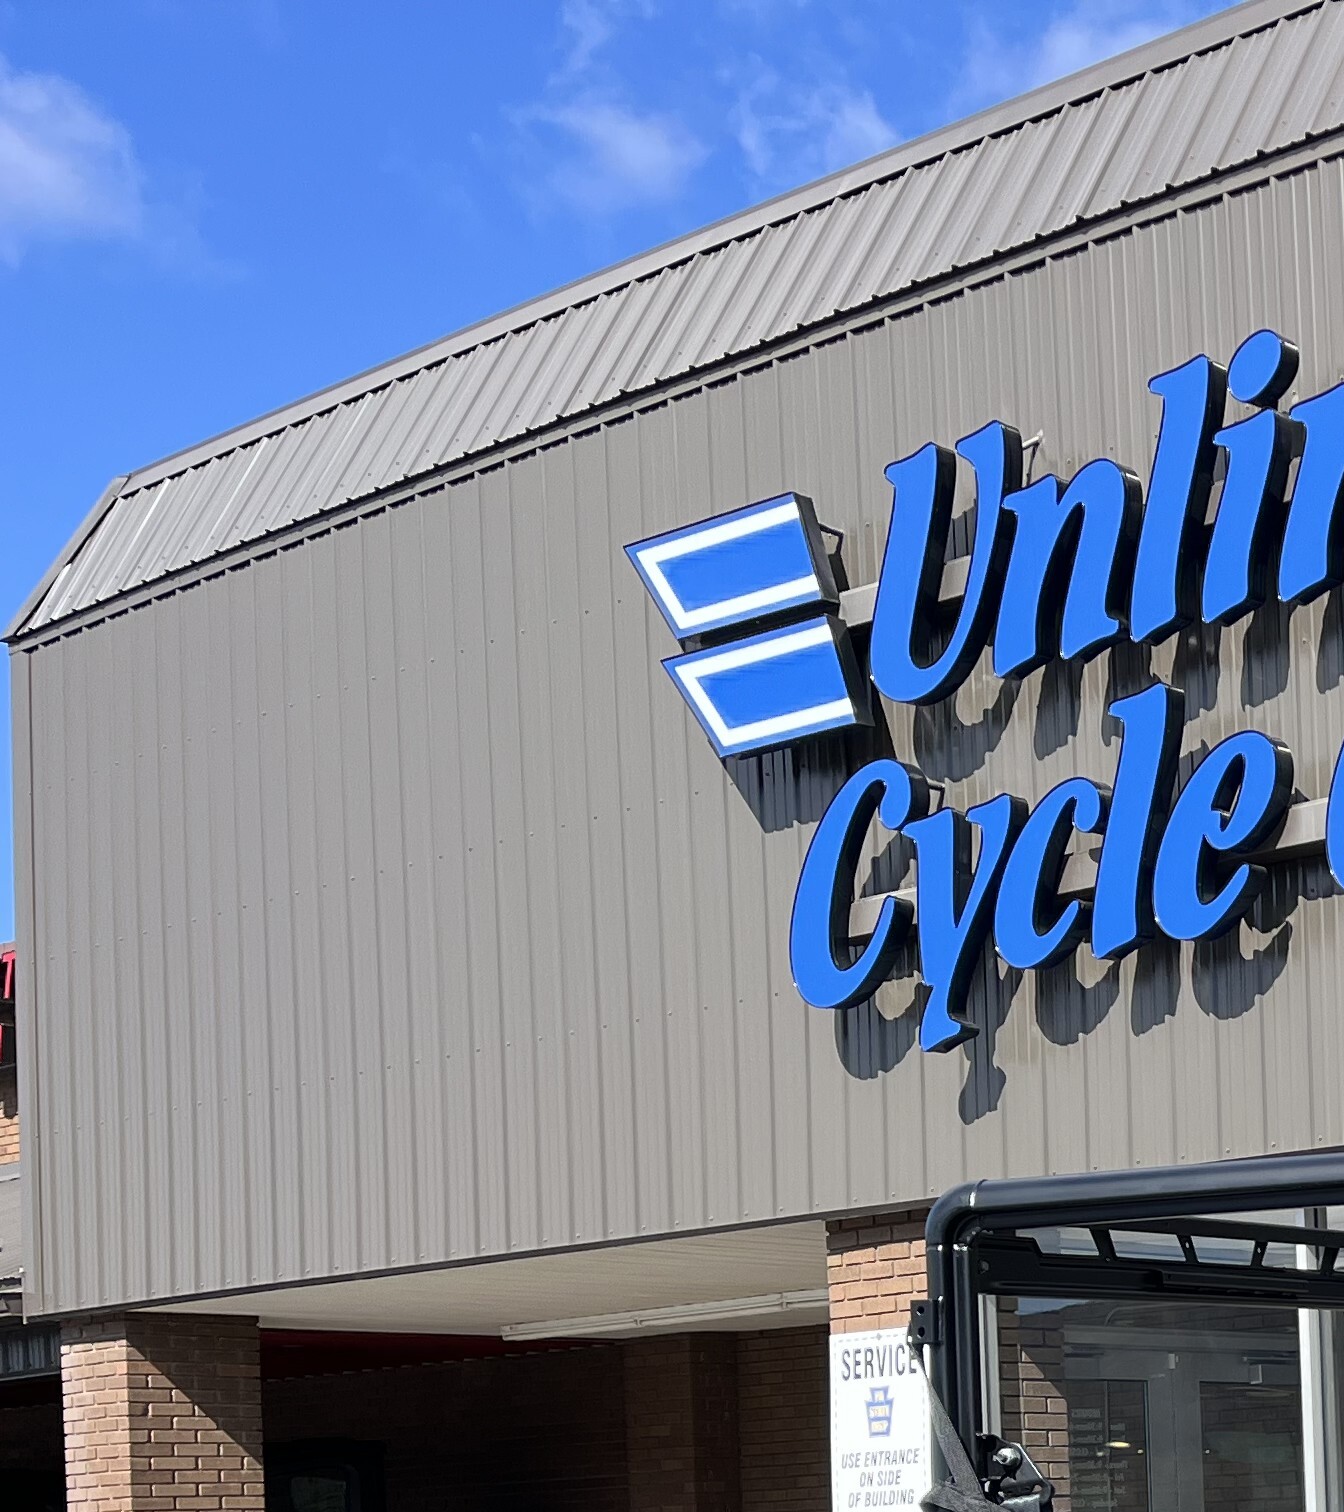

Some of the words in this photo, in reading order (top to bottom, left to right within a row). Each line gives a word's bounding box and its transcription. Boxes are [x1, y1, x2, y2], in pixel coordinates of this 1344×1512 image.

[790, 685, 1278, 1052] Cycle
[841, 1452, 861, 1470] USE
[864, 1448, 919, 1468] ENTRANCE
[859, 1470, 875, 1487] ON
[877, 1468, 901, 1486] SIDE
[848, 1491, 862, 1508] OF
[864, 1488, 914, 1507] BUILDING
